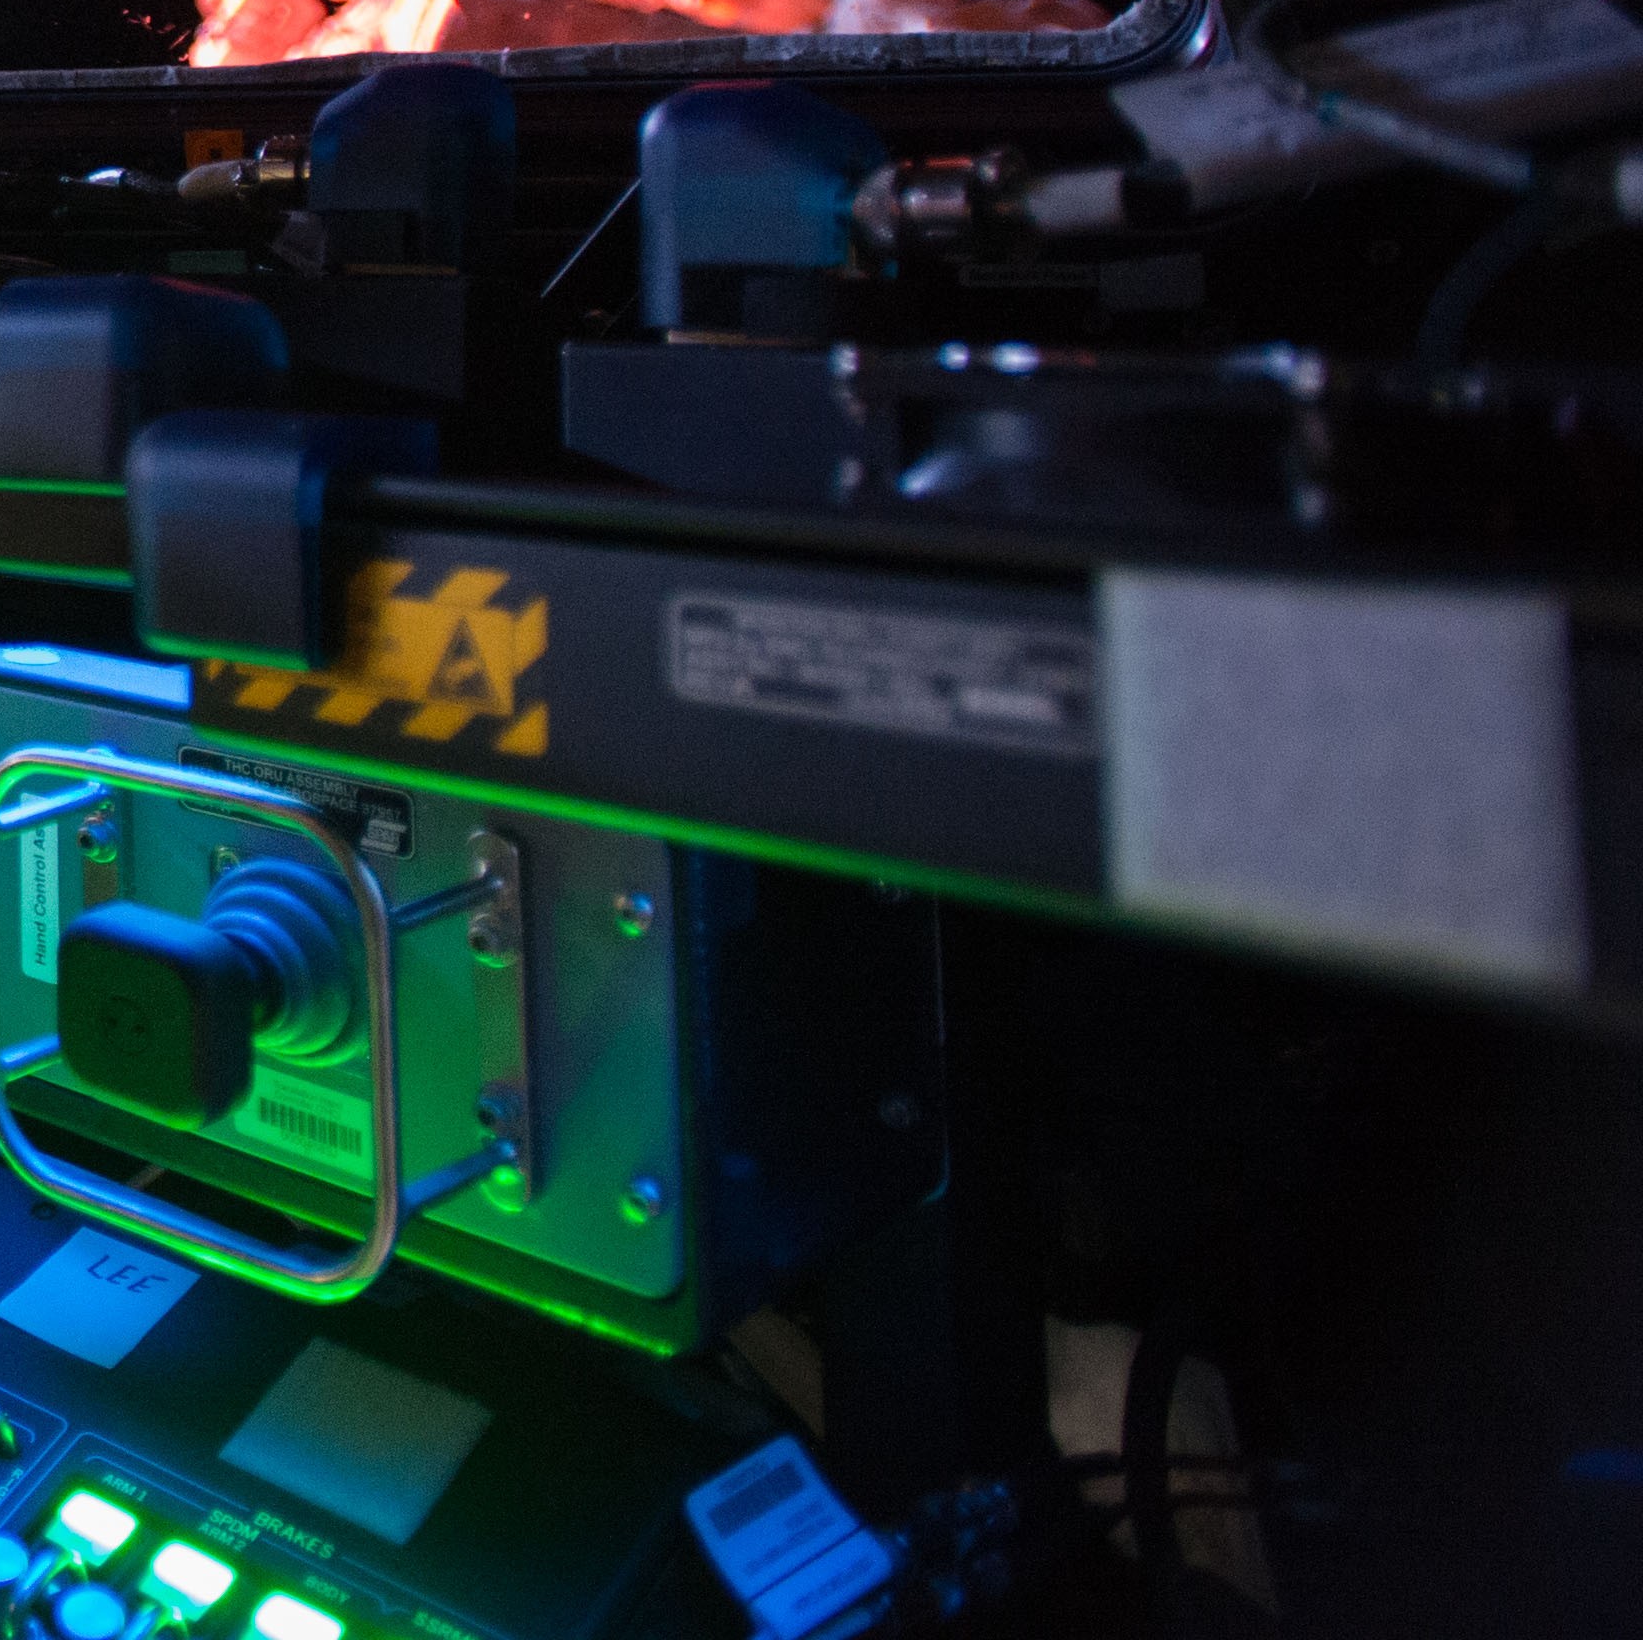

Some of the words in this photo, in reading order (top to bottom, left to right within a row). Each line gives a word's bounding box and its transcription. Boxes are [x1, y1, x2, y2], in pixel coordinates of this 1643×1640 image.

[285, 772, 360, 799] ASSEMBLY
[34, 854, 47, 924] Control
[35, 931, 47, 966] Hand
[86, 1254, 170, 1294] LEE
[102, 1472, 137, 1496] ARM
[209, 1508, 261, 1543] SPDM
[252, 1510, 337, 1560] BRAKES
